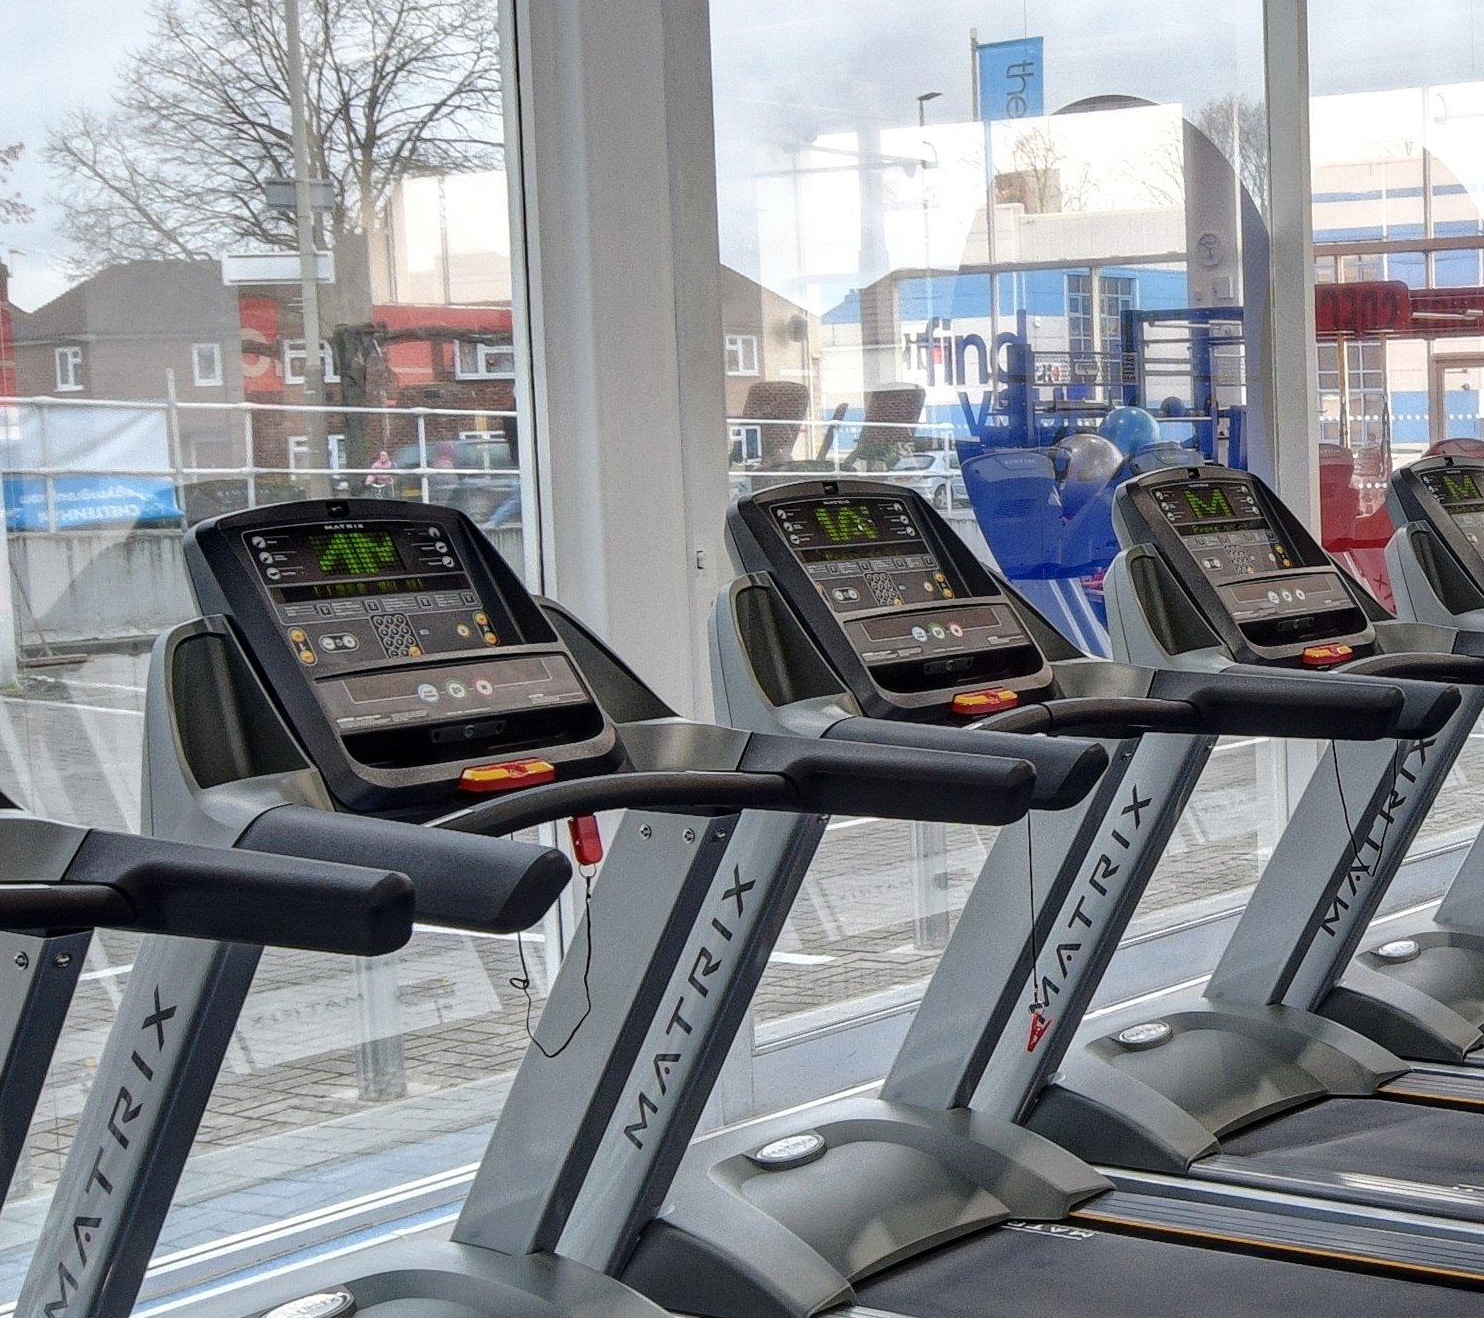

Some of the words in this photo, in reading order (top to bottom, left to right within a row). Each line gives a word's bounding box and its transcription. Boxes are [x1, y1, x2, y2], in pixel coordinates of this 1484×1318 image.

[1006, 60, 1034, 119] the
[1030, 783, 1153, 1023] MATRIX
[1321, 738, 1437, 937] MATRIX
[621, 861, 757, 1151] MATRIX
